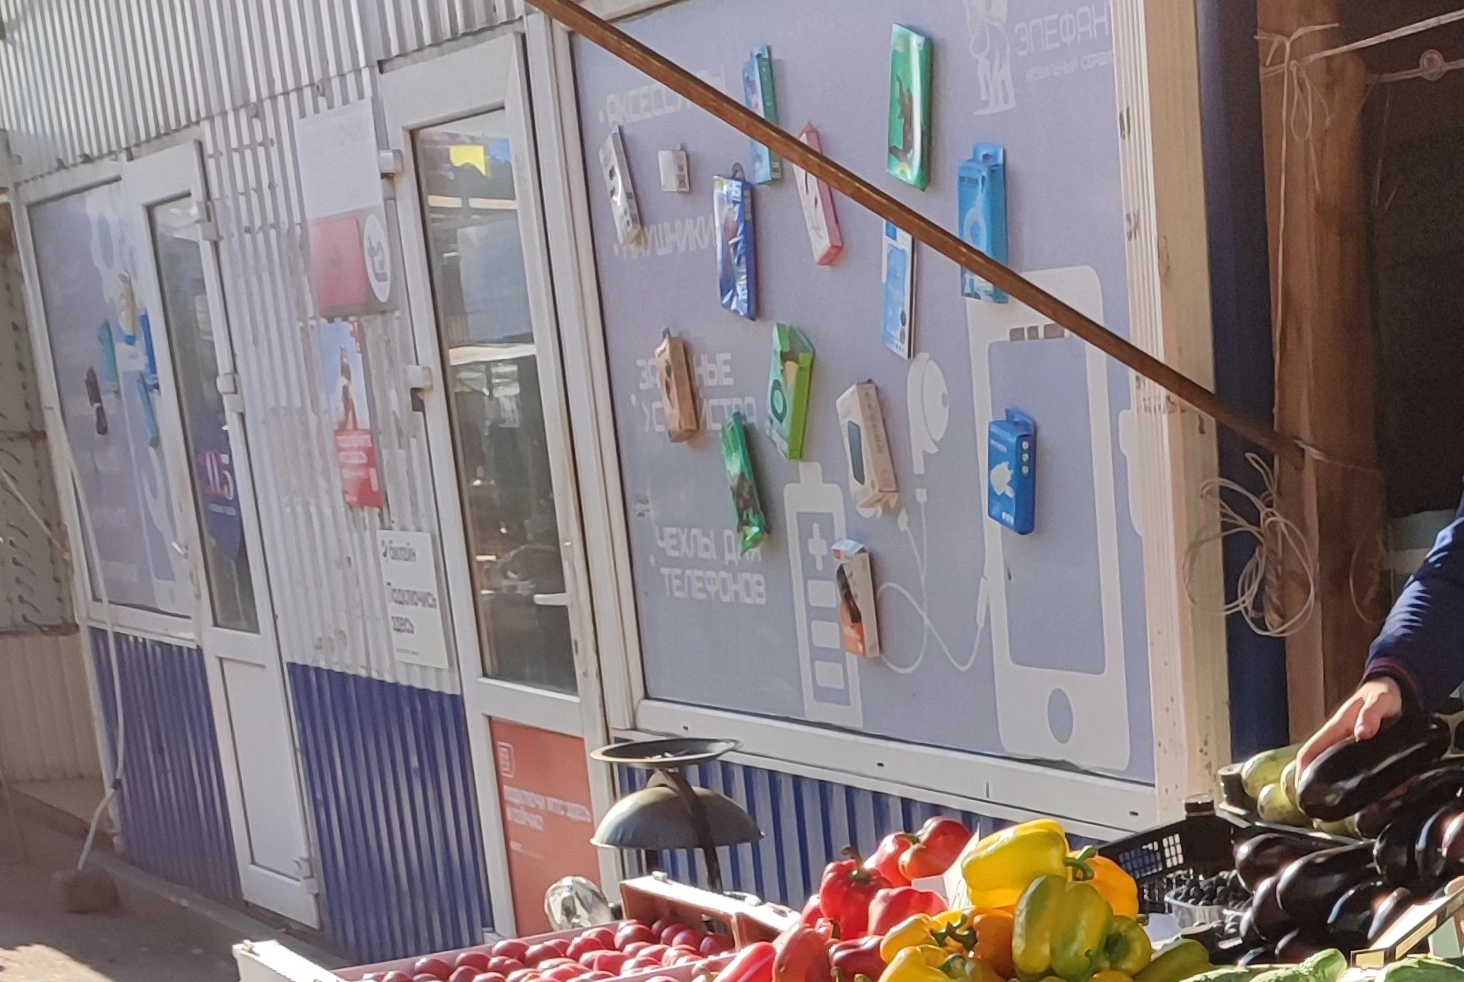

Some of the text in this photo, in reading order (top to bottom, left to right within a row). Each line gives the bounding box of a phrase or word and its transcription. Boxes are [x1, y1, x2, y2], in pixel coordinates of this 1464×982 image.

[1014, 3, 1112, 57] ЭЛЕФАН
[656, 526, 714, 557] ЧЕХЛЫ
[660, 567, 766, 605] ТЕЛЕФОНОВ
